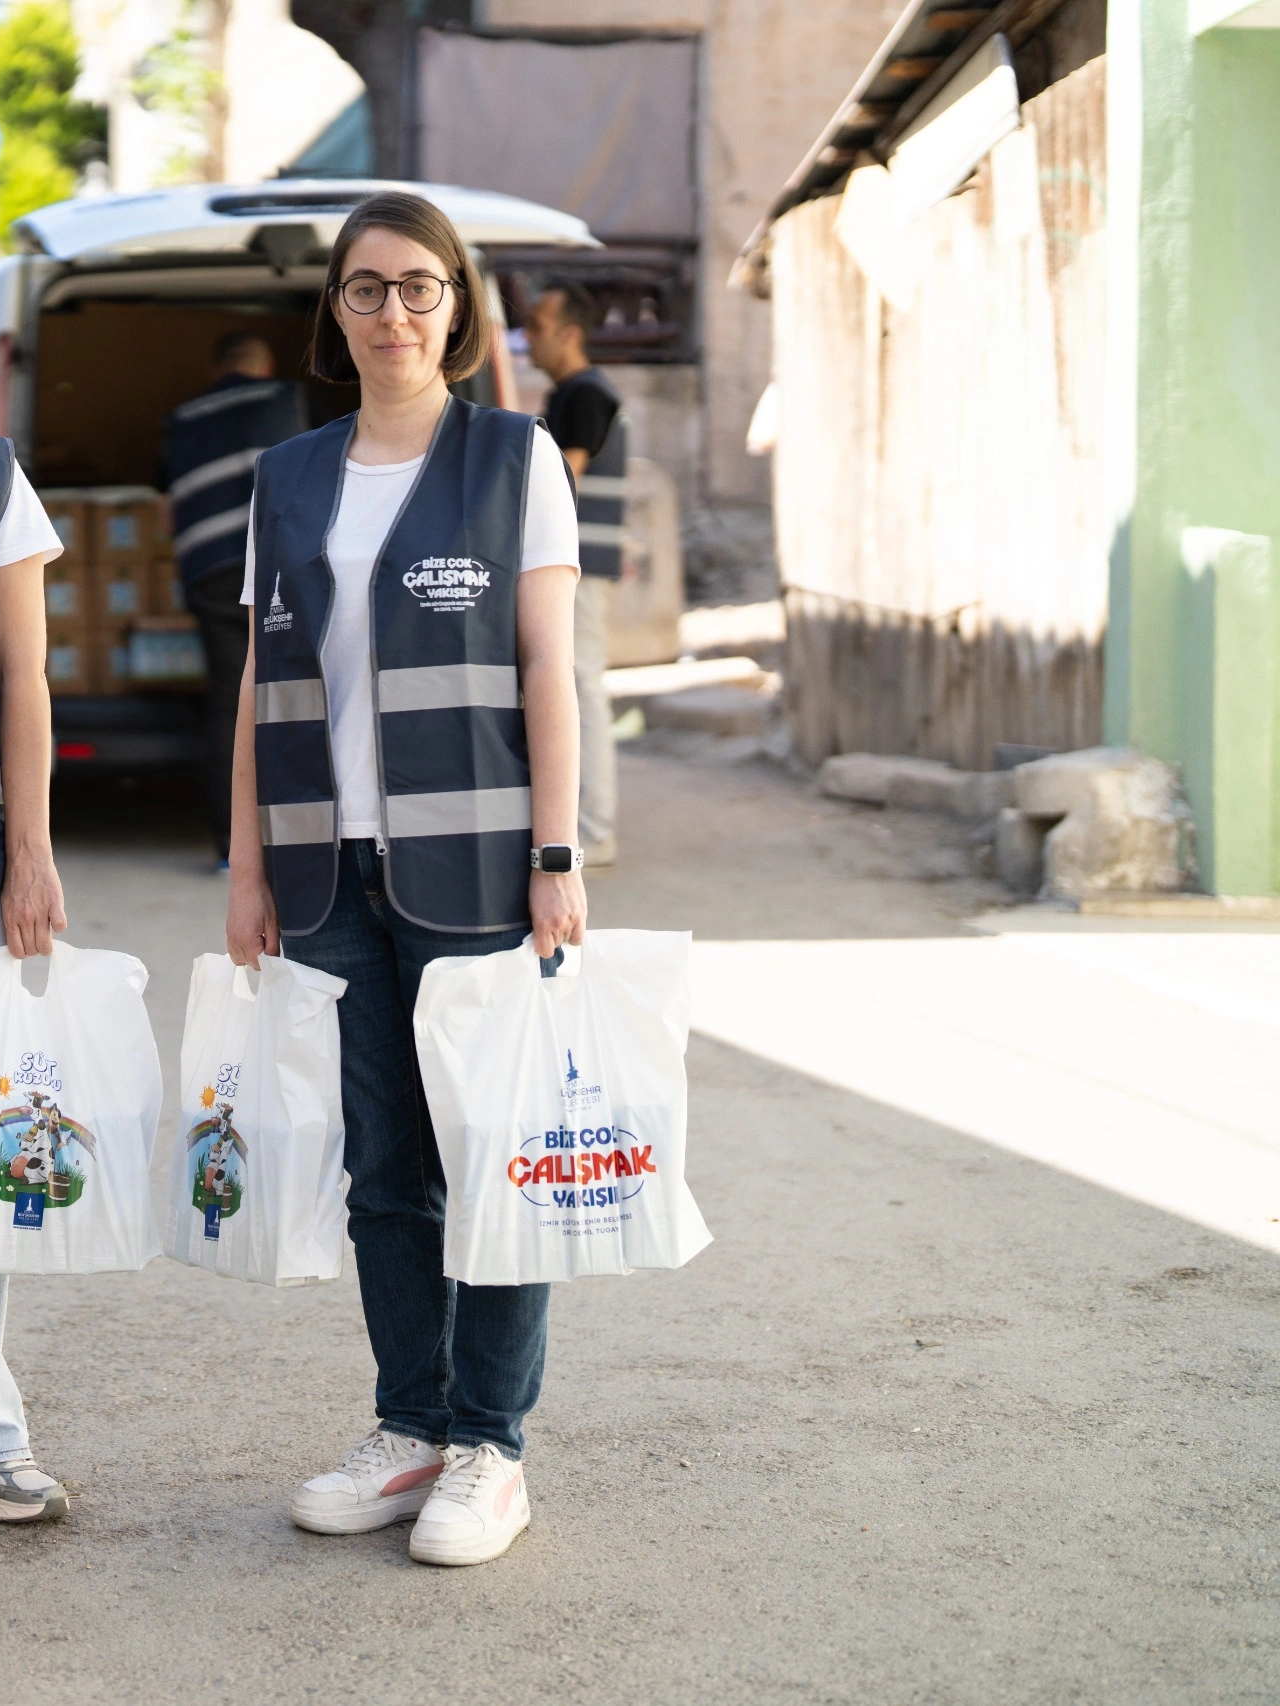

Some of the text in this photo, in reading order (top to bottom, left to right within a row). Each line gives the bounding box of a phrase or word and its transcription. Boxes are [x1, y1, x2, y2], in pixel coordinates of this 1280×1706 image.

[422, 556, 472, 569] BİZE ÇOK
[402, 569, 491, 588] ÇALIŞMAK
[426, 587, 470, 599] YAKIŞIR
[507, 1145, 657, 1188] ÇALIŞMAK
